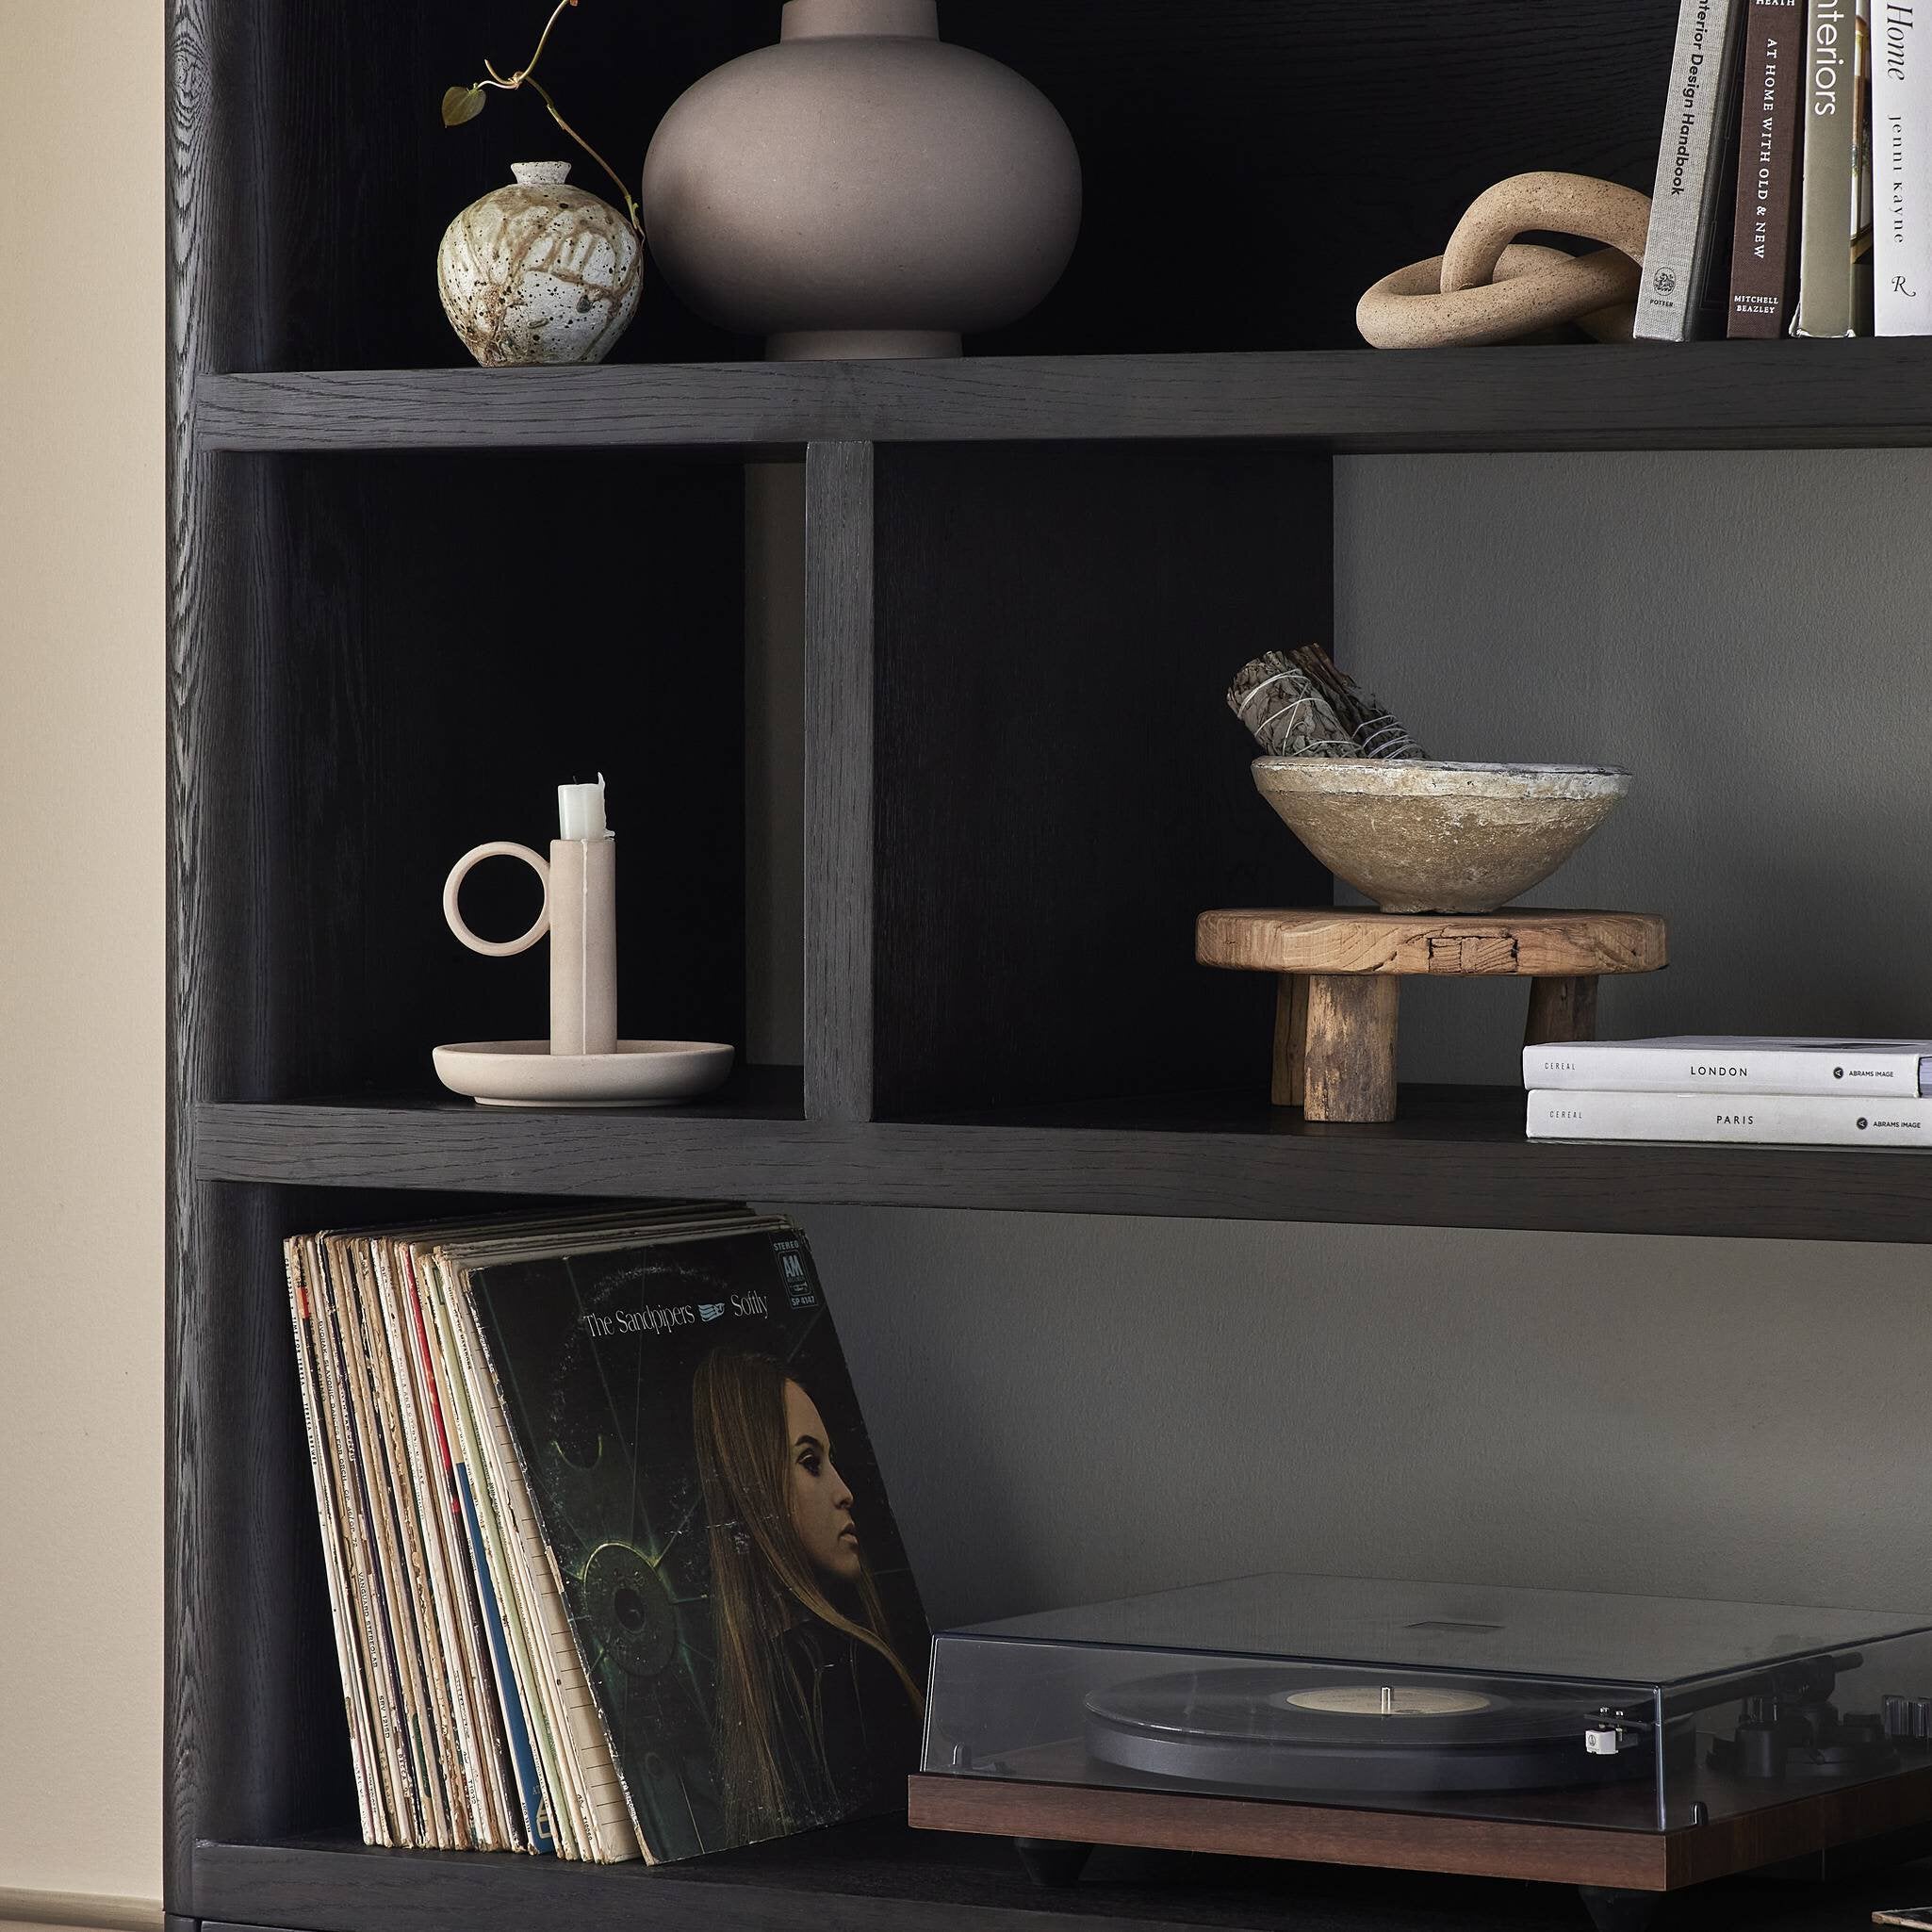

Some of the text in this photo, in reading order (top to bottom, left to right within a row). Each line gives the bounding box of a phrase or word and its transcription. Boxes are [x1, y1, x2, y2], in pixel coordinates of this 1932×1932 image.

[1887, 4, 1913, 80] Home
[1683, 54, 1703, 108] Design
[1671, 113, 1695, 195] Handbook
[1754, 38, 1777, 259] AT HOME WITH OLD & NEW
[1649, 299, 1674, 307] POTTER
[1734, 295, 1779, 304] MITCHELL
[1736, 304, 1776, 314] BEAZLEY
[1545, 1062, 1576, 1071] CEREAL
[1690, 1066, 1748, 1076] LONDON
[1549, 1110, 1582, 1119] CEREAL
[1716, 1115, 1754, 1124] PARIS
[773, 1240, 799, 1252] STEREO
[583, 1290, 769, 1337] The Sandpipers Softly
[356, 1571, 378, 1668] VANGUARD STEREOLAB
